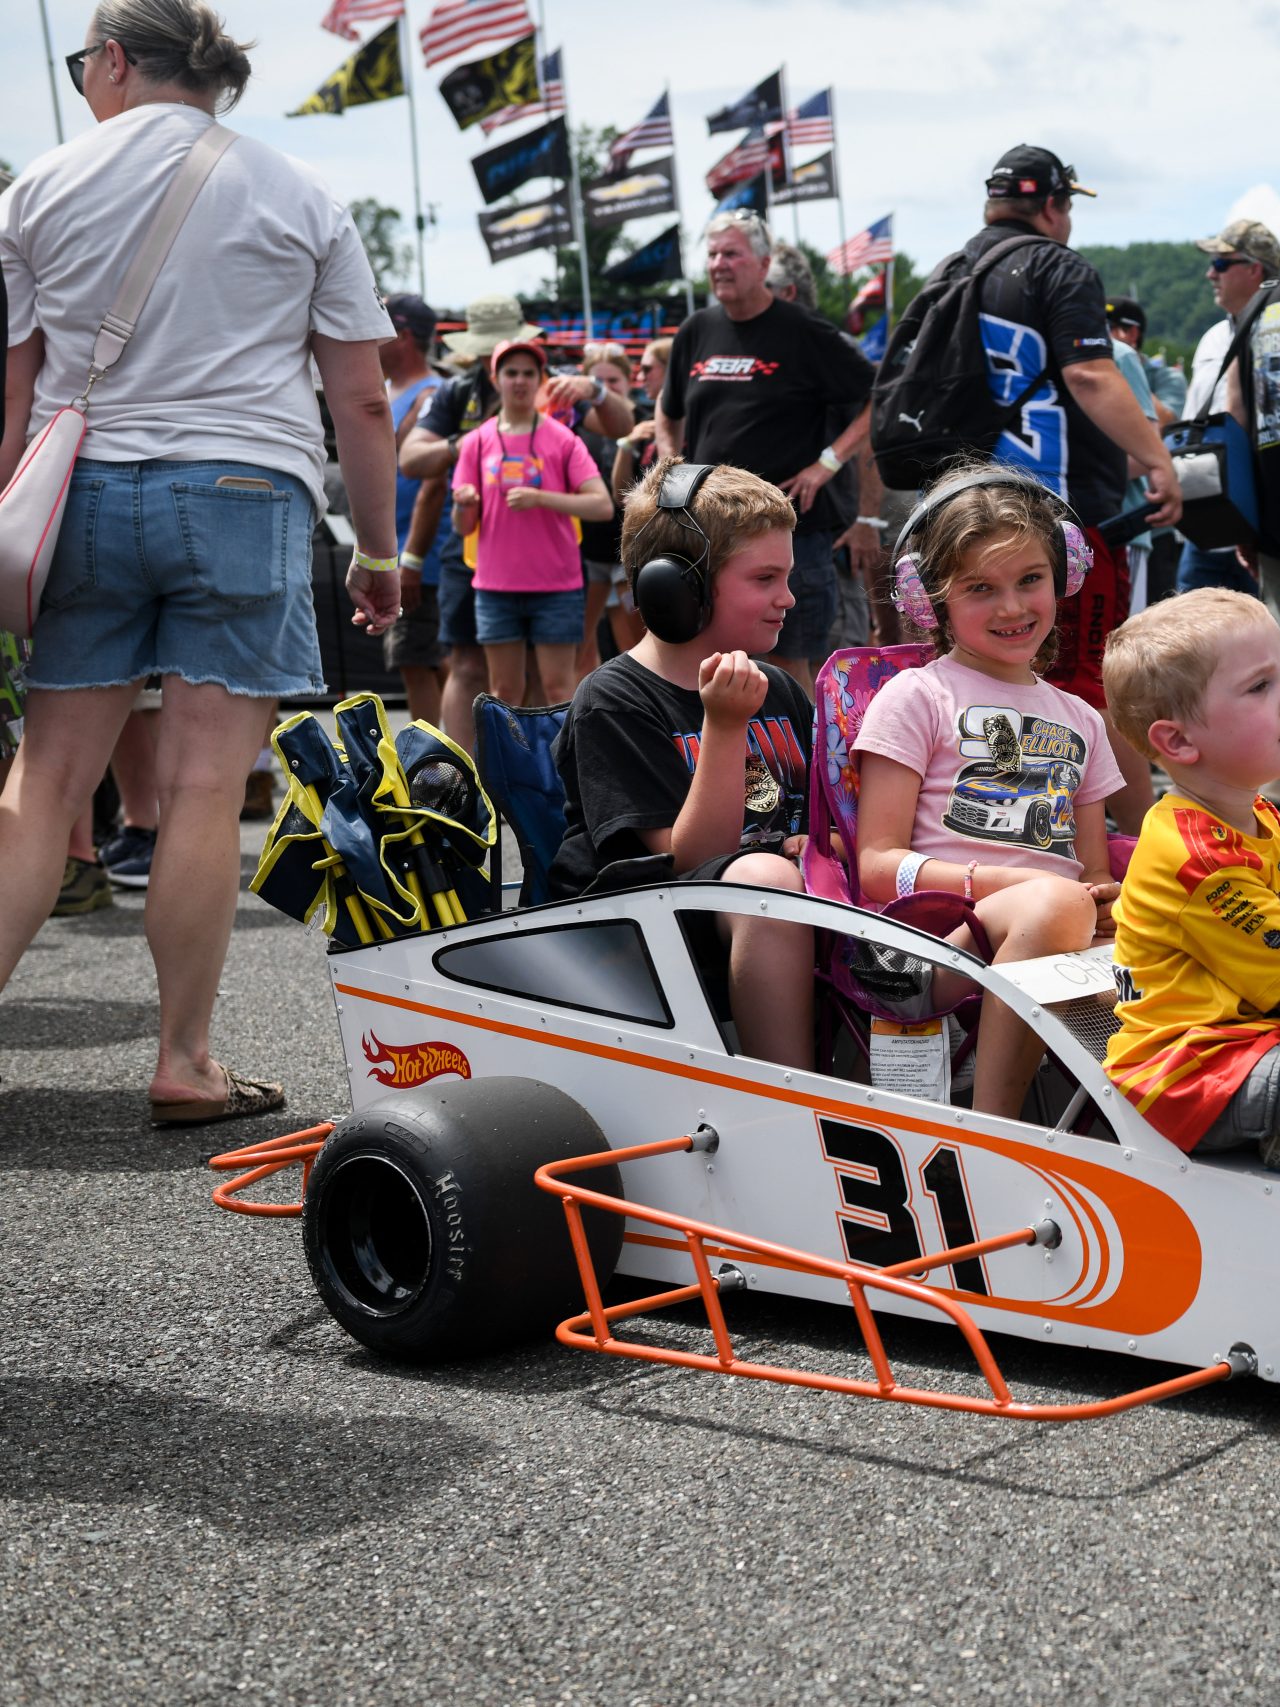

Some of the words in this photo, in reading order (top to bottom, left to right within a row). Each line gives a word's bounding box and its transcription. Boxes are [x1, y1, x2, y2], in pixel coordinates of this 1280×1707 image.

[1031, 719, 1073, 741] CHASE
[1021, 734, 1080, 761] ELLIOTT
[1205, 880, 1231, 903] FORD
[816, 1113, 990, 1296] 31
